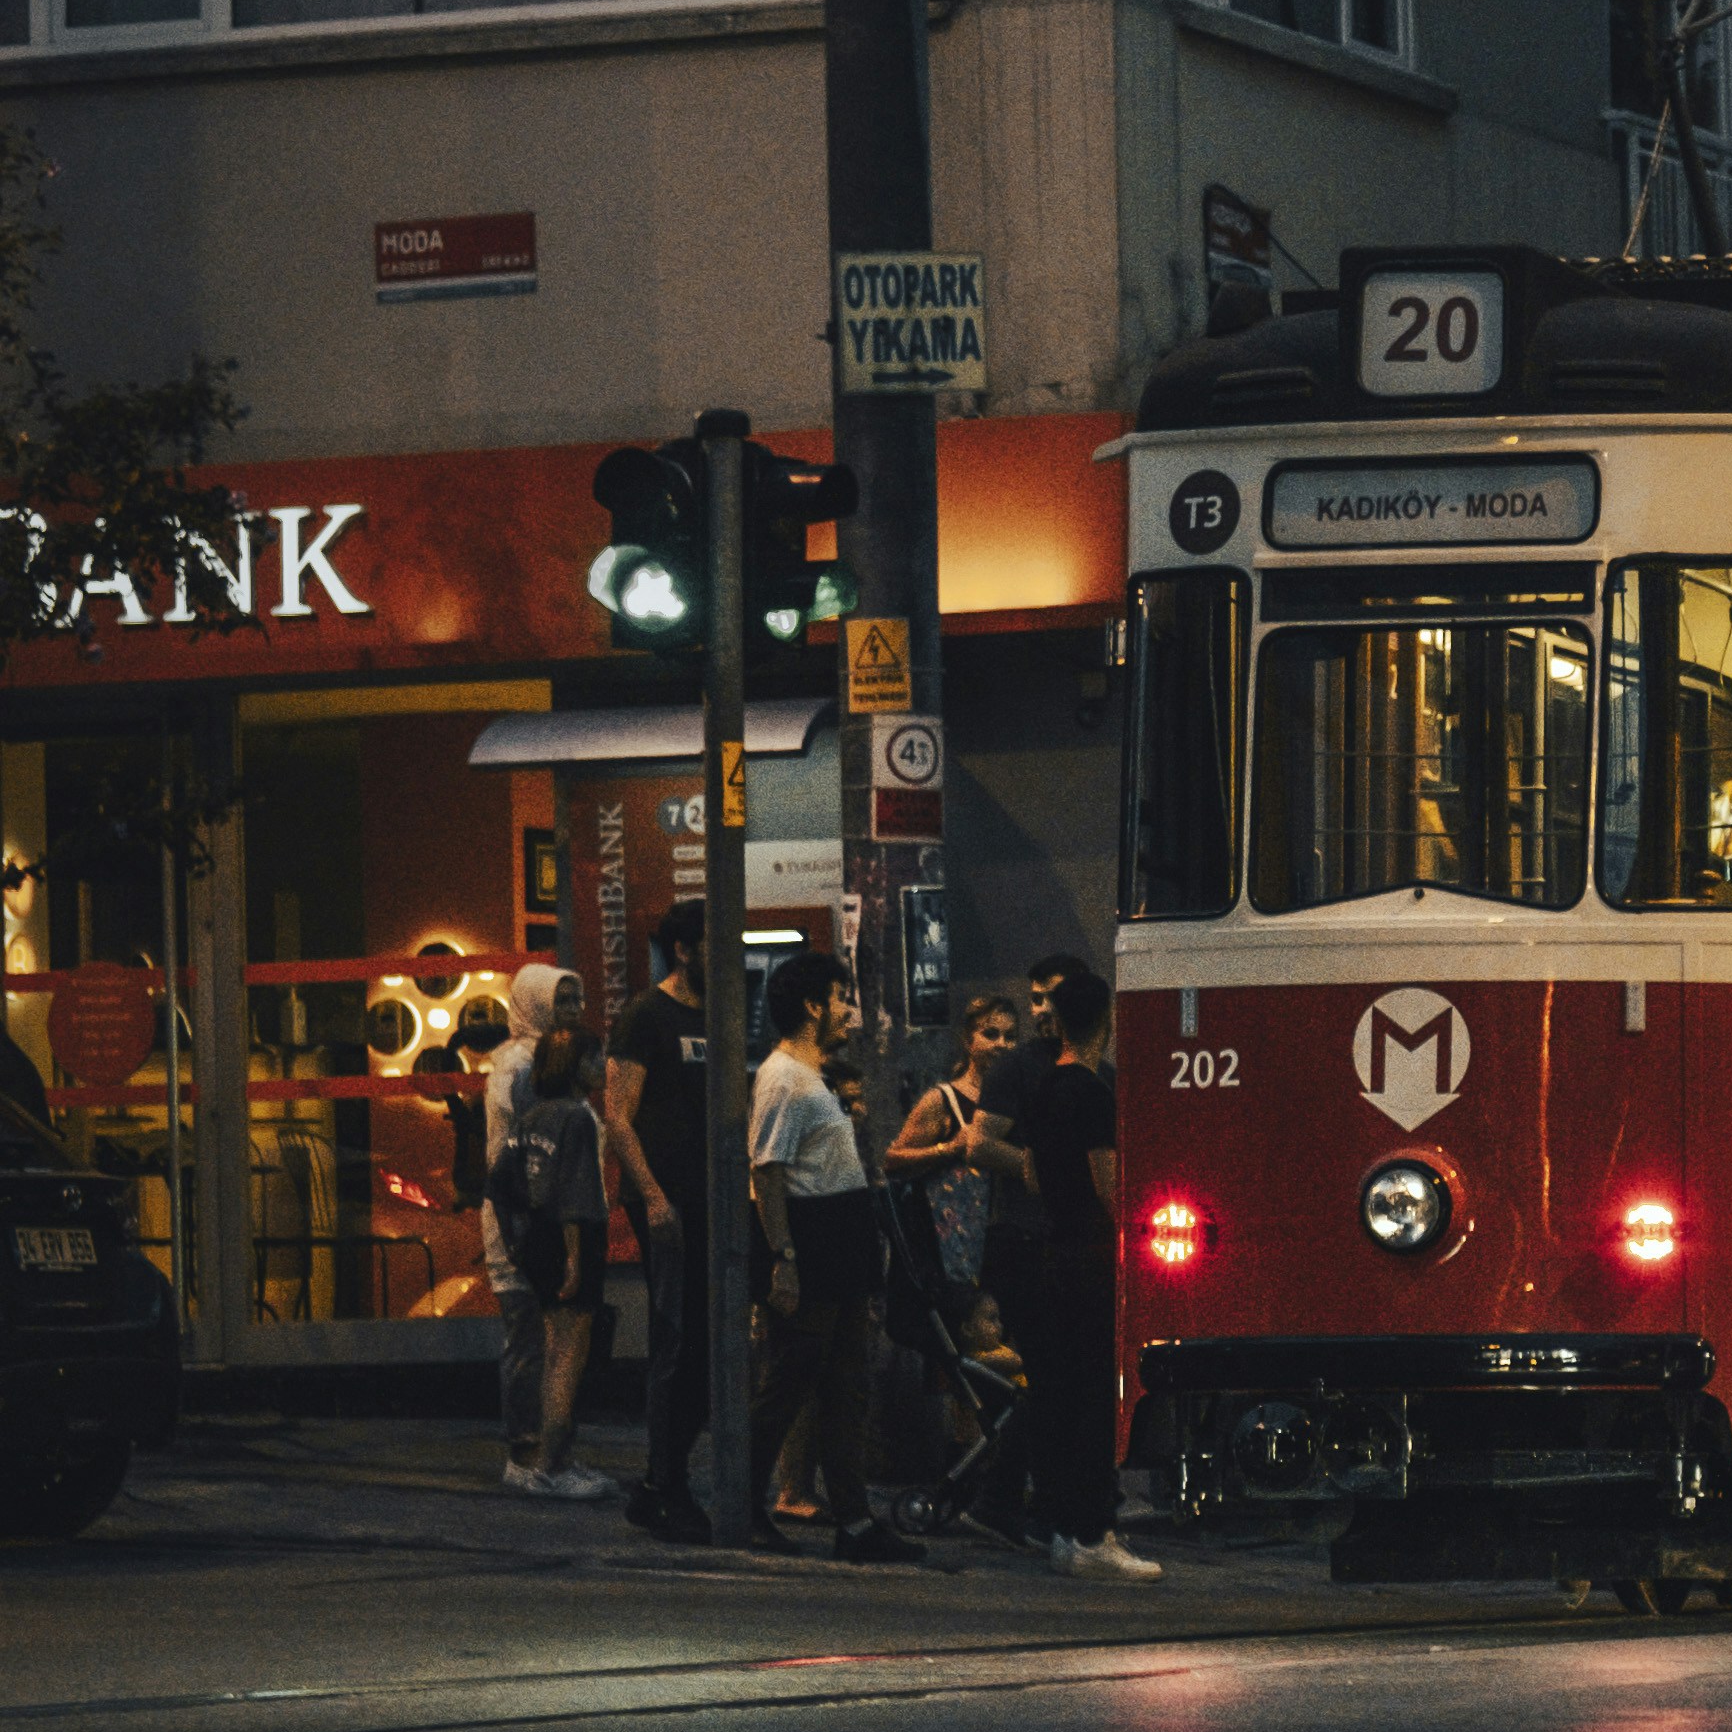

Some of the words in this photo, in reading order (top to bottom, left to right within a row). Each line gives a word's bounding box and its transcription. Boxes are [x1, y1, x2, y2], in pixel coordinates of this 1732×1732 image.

[381, 229, 444, 256] MODA
[844, 264, 980, 310] OTOPARK
[848, 318, 982, 364] YIKAMA
[1383, 296, 1479, 362] 20
[1184, 495, 1222, 528] T3
[1316, 489, 1439, 521] KADIKÖY
[1465, 492, 1548, 519] MODA
[598, 802, 627, 1023] RKISHBANK
[1169, 1048, 1241, 1090] 202
